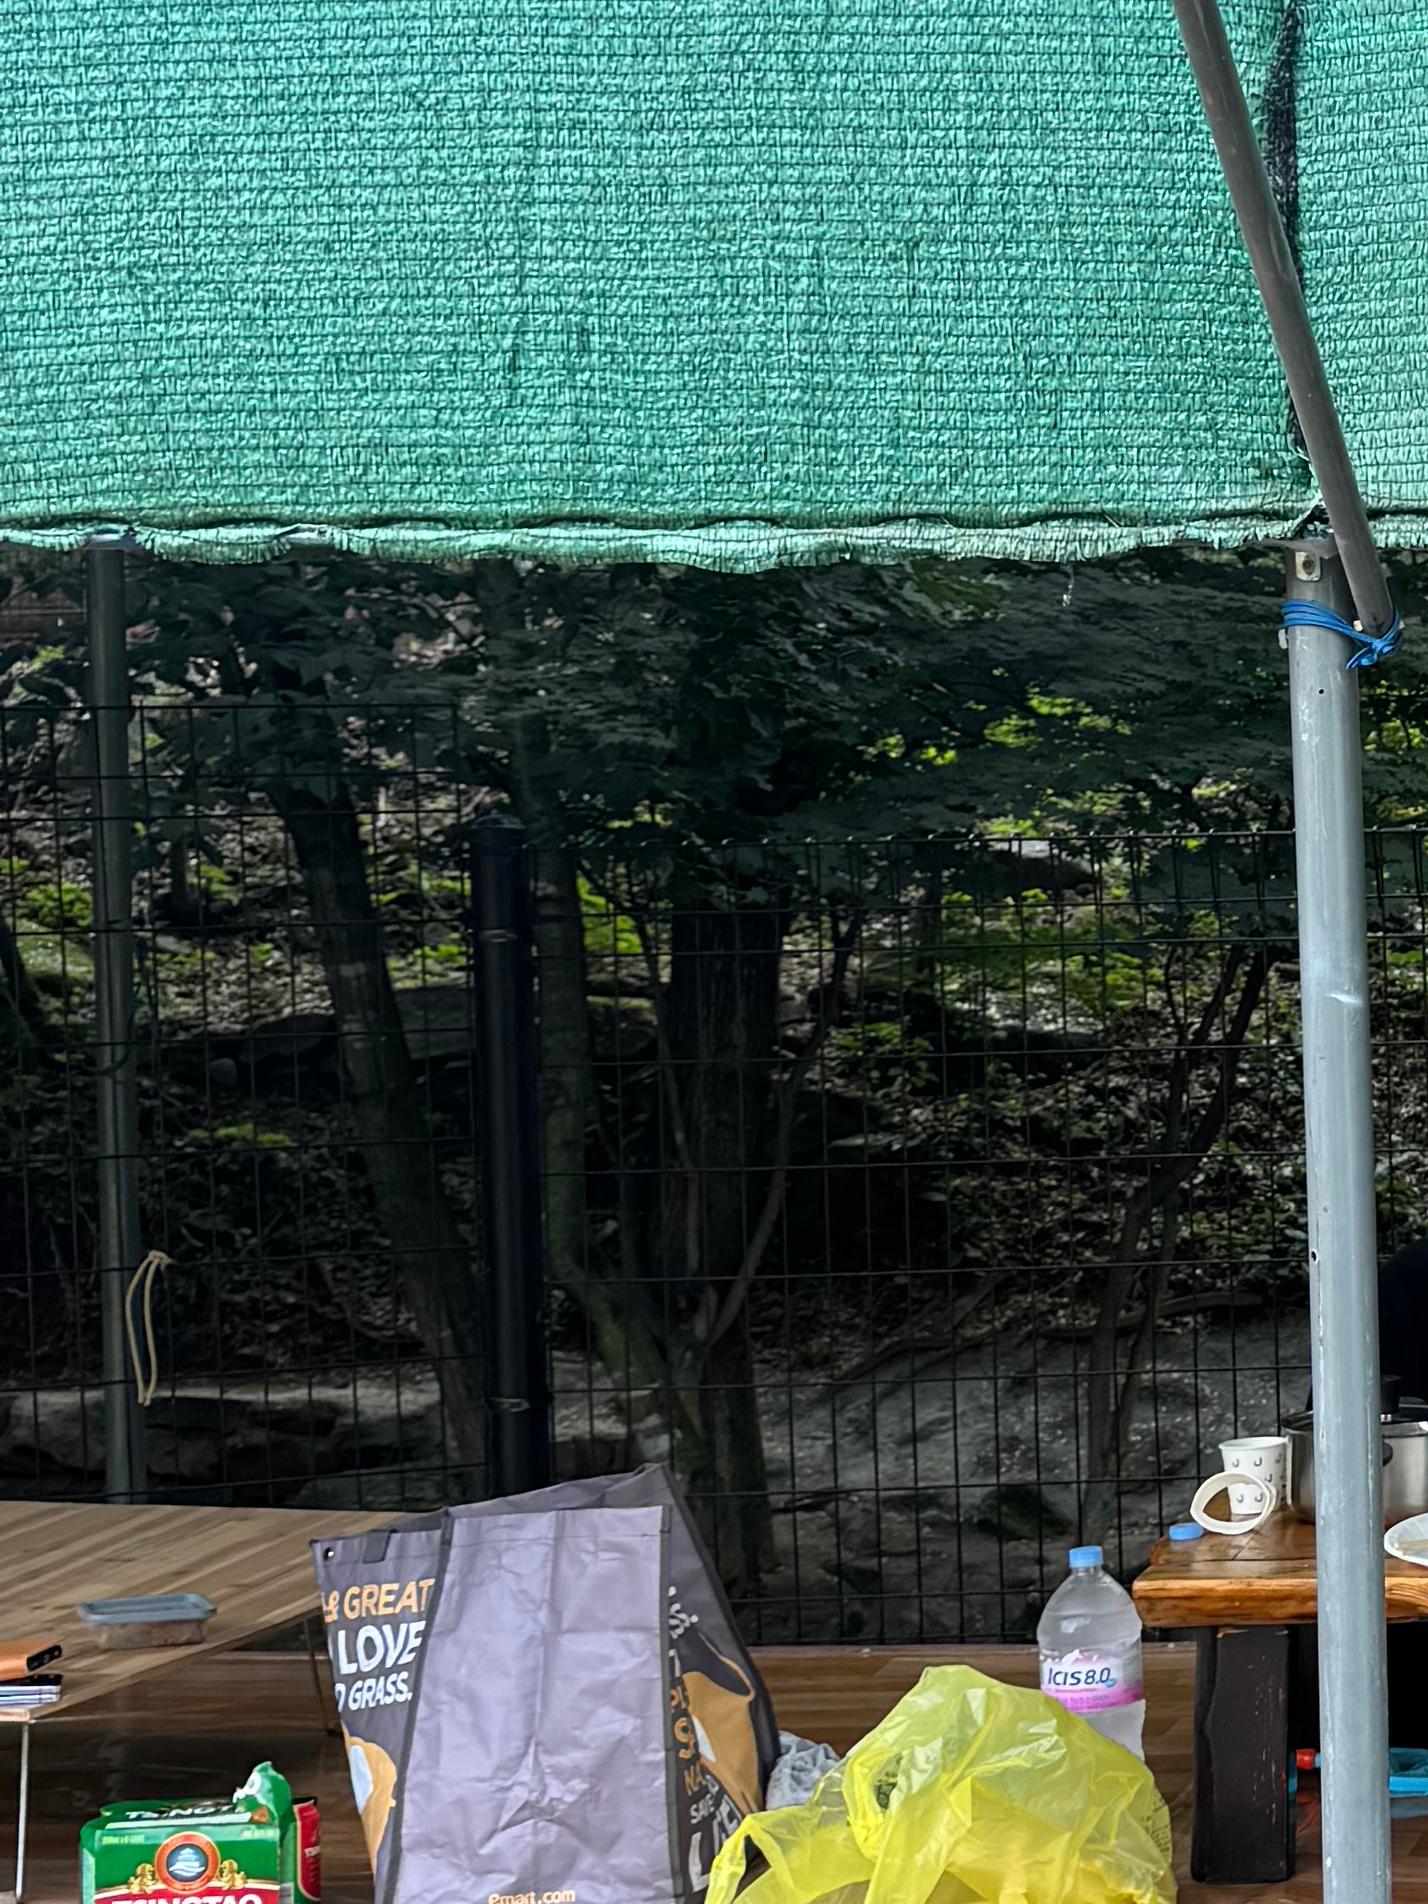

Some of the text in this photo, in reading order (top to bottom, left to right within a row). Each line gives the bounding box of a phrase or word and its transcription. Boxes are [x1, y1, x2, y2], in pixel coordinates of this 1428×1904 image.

[343, 1578, 436, 1620] GREAT
[337, 1620, 426, 1675] LOVE
[348, 1671, 413, 1711] GRASS.
